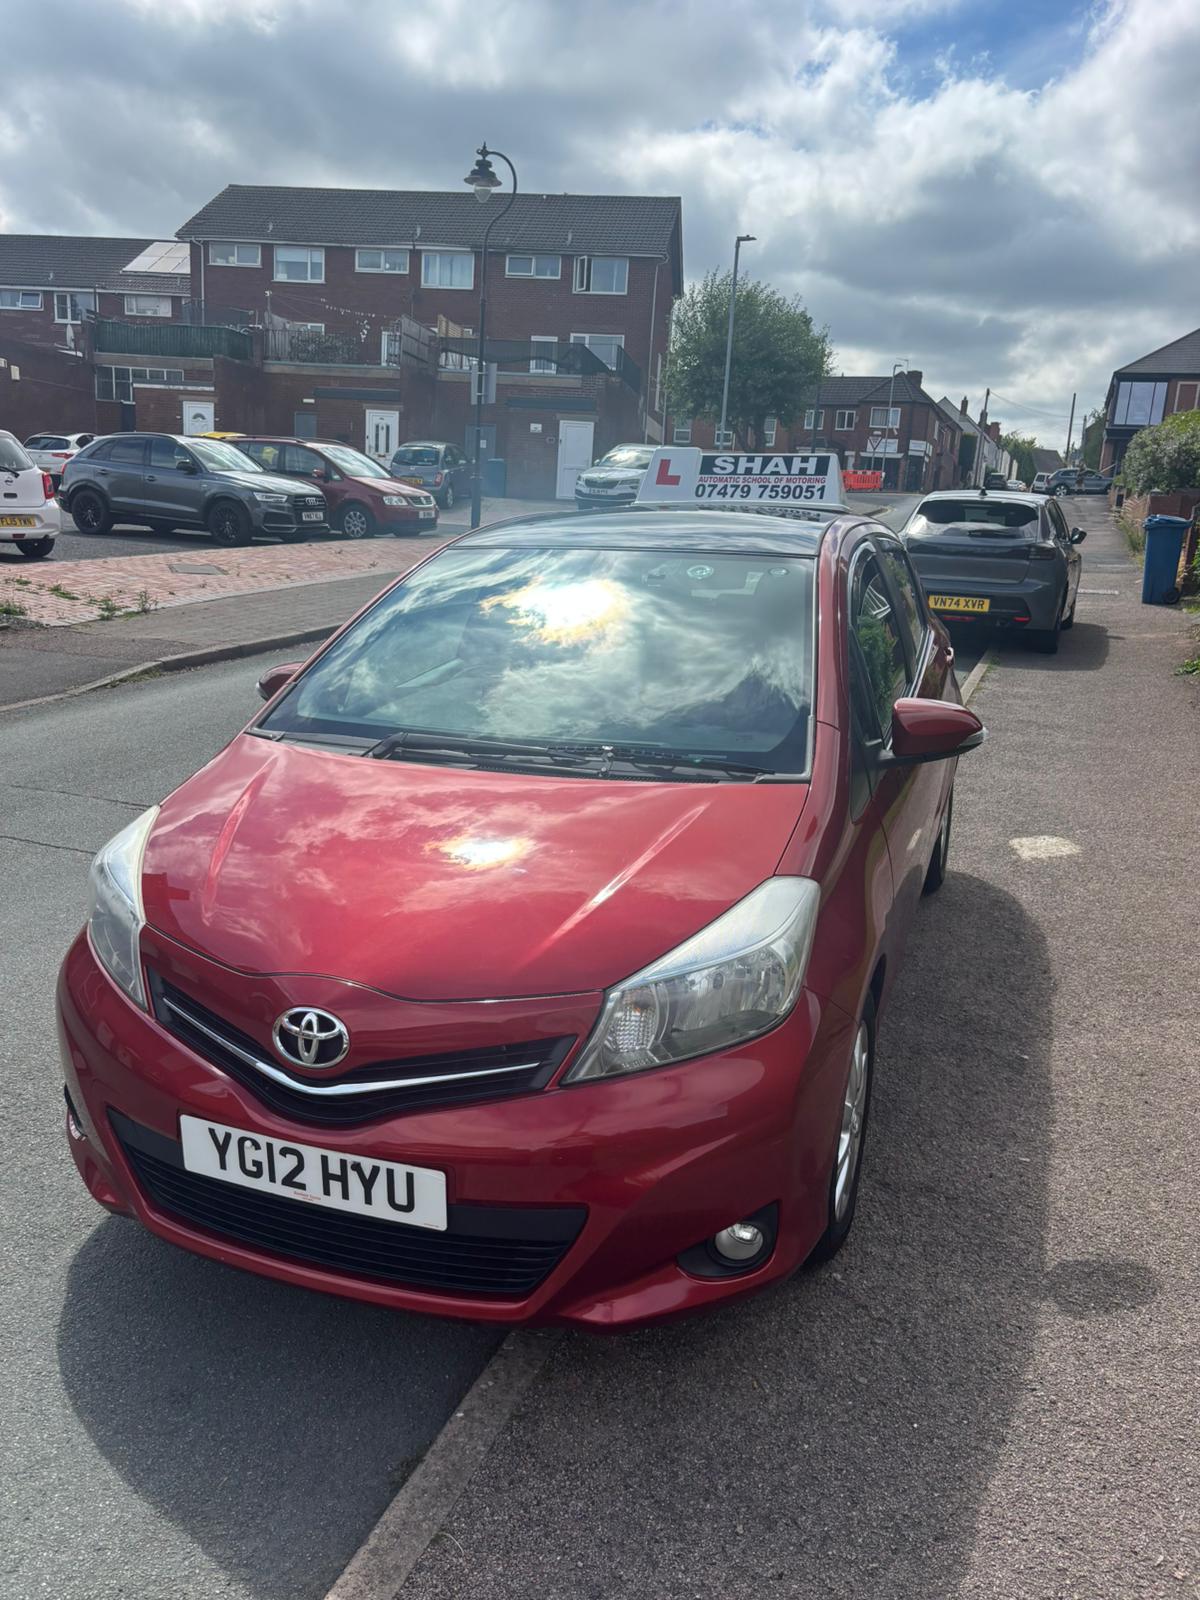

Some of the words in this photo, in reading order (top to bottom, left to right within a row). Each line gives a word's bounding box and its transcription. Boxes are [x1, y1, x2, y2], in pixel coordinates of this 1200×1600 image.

[656, 459, 681, 486] L
[712, 456, 818, 475] SHAH
[698, 476, 741, 484] AUTOMATIC
[741, 476, 772, 484] SCHOOL
[694, 484, 752, 498] 07479
[758, 484, 826, 500] 759051
[933, 597, 960, 608] VN74
[963, 598, 985, 609] XVR
[208, 1127, 307, 1191] YG12
[320, 1154, 415, 1214] HYU
